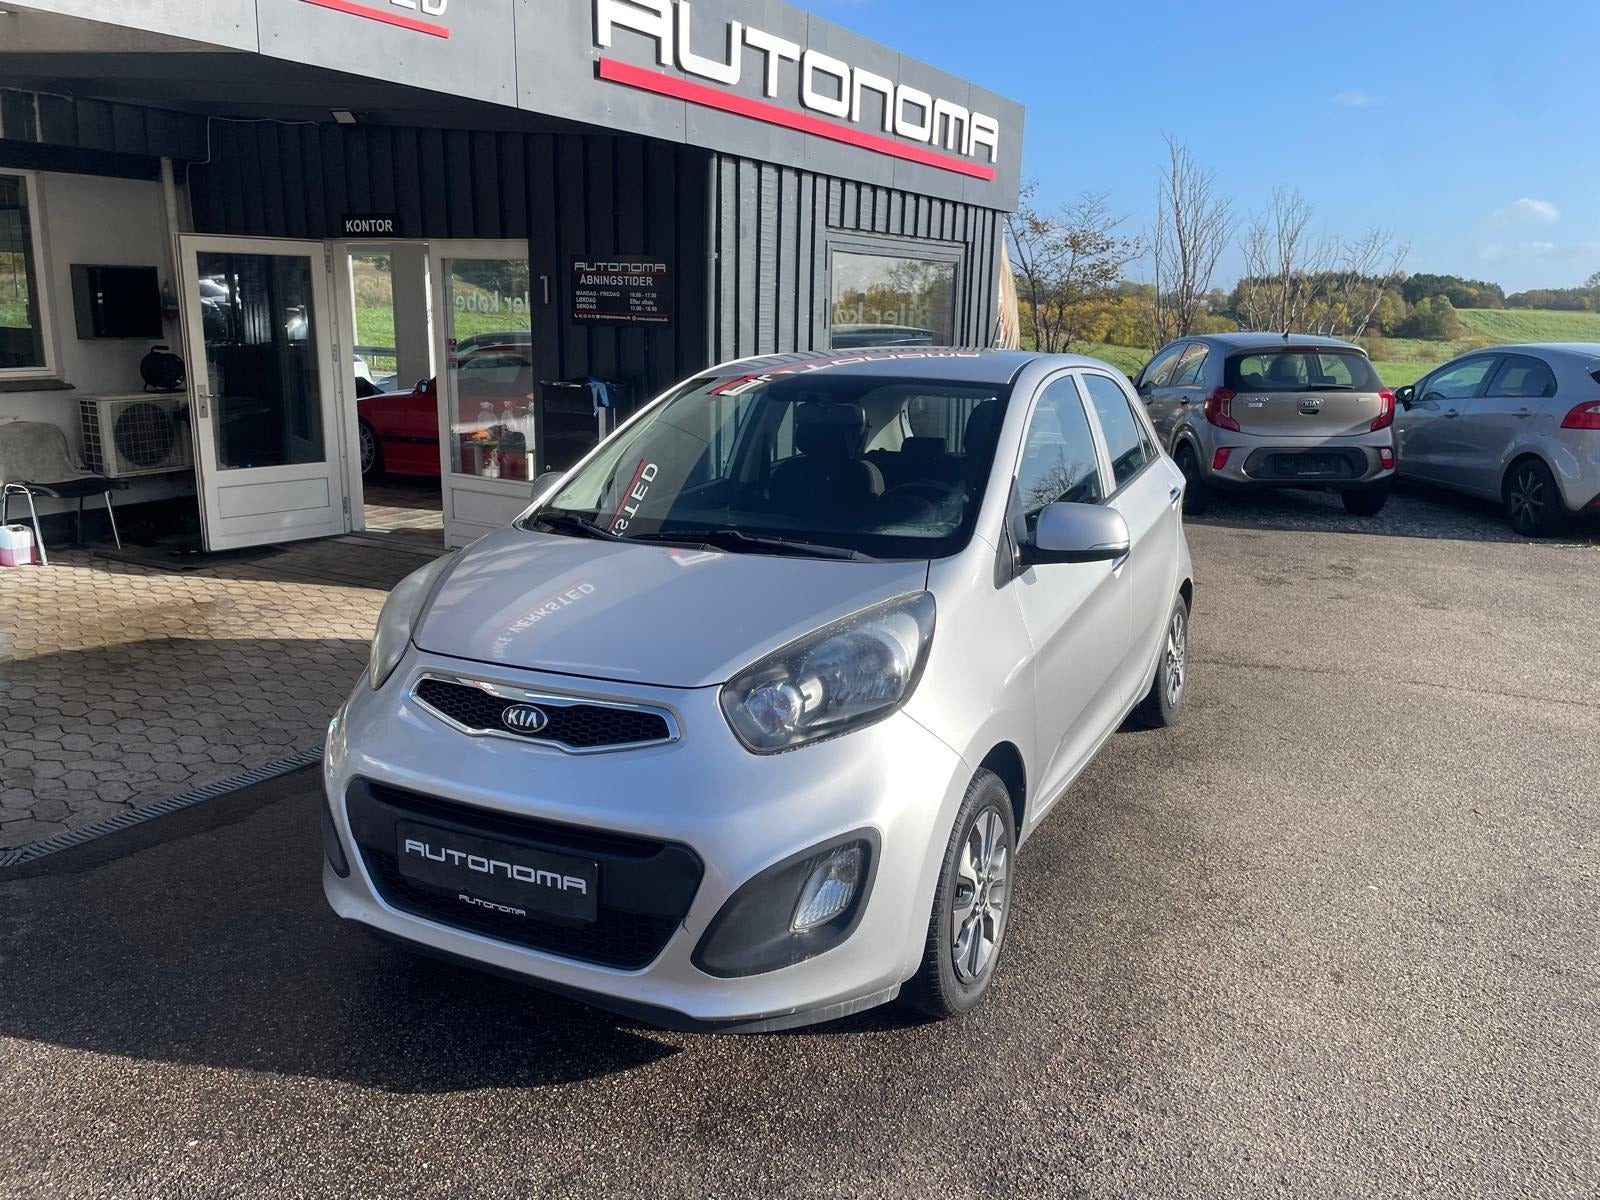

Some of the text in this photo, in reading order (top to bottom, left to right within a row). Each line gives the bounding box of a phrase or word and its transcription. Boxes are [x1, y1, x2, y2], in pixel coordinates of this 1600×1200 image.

[597, 0, 999, 163] AUTONOMA
[345, 219, 394, 233] KONTOR
[574, 262, 667, 273] AUTONOMA
[580, 273, 654, 287] ÅBNINGSTIDER
[507, 709, 538, 728] KIA
[405, 839, 587, 895] AUTONOMA
[459, 894, 527, 917] AUTONOMA
